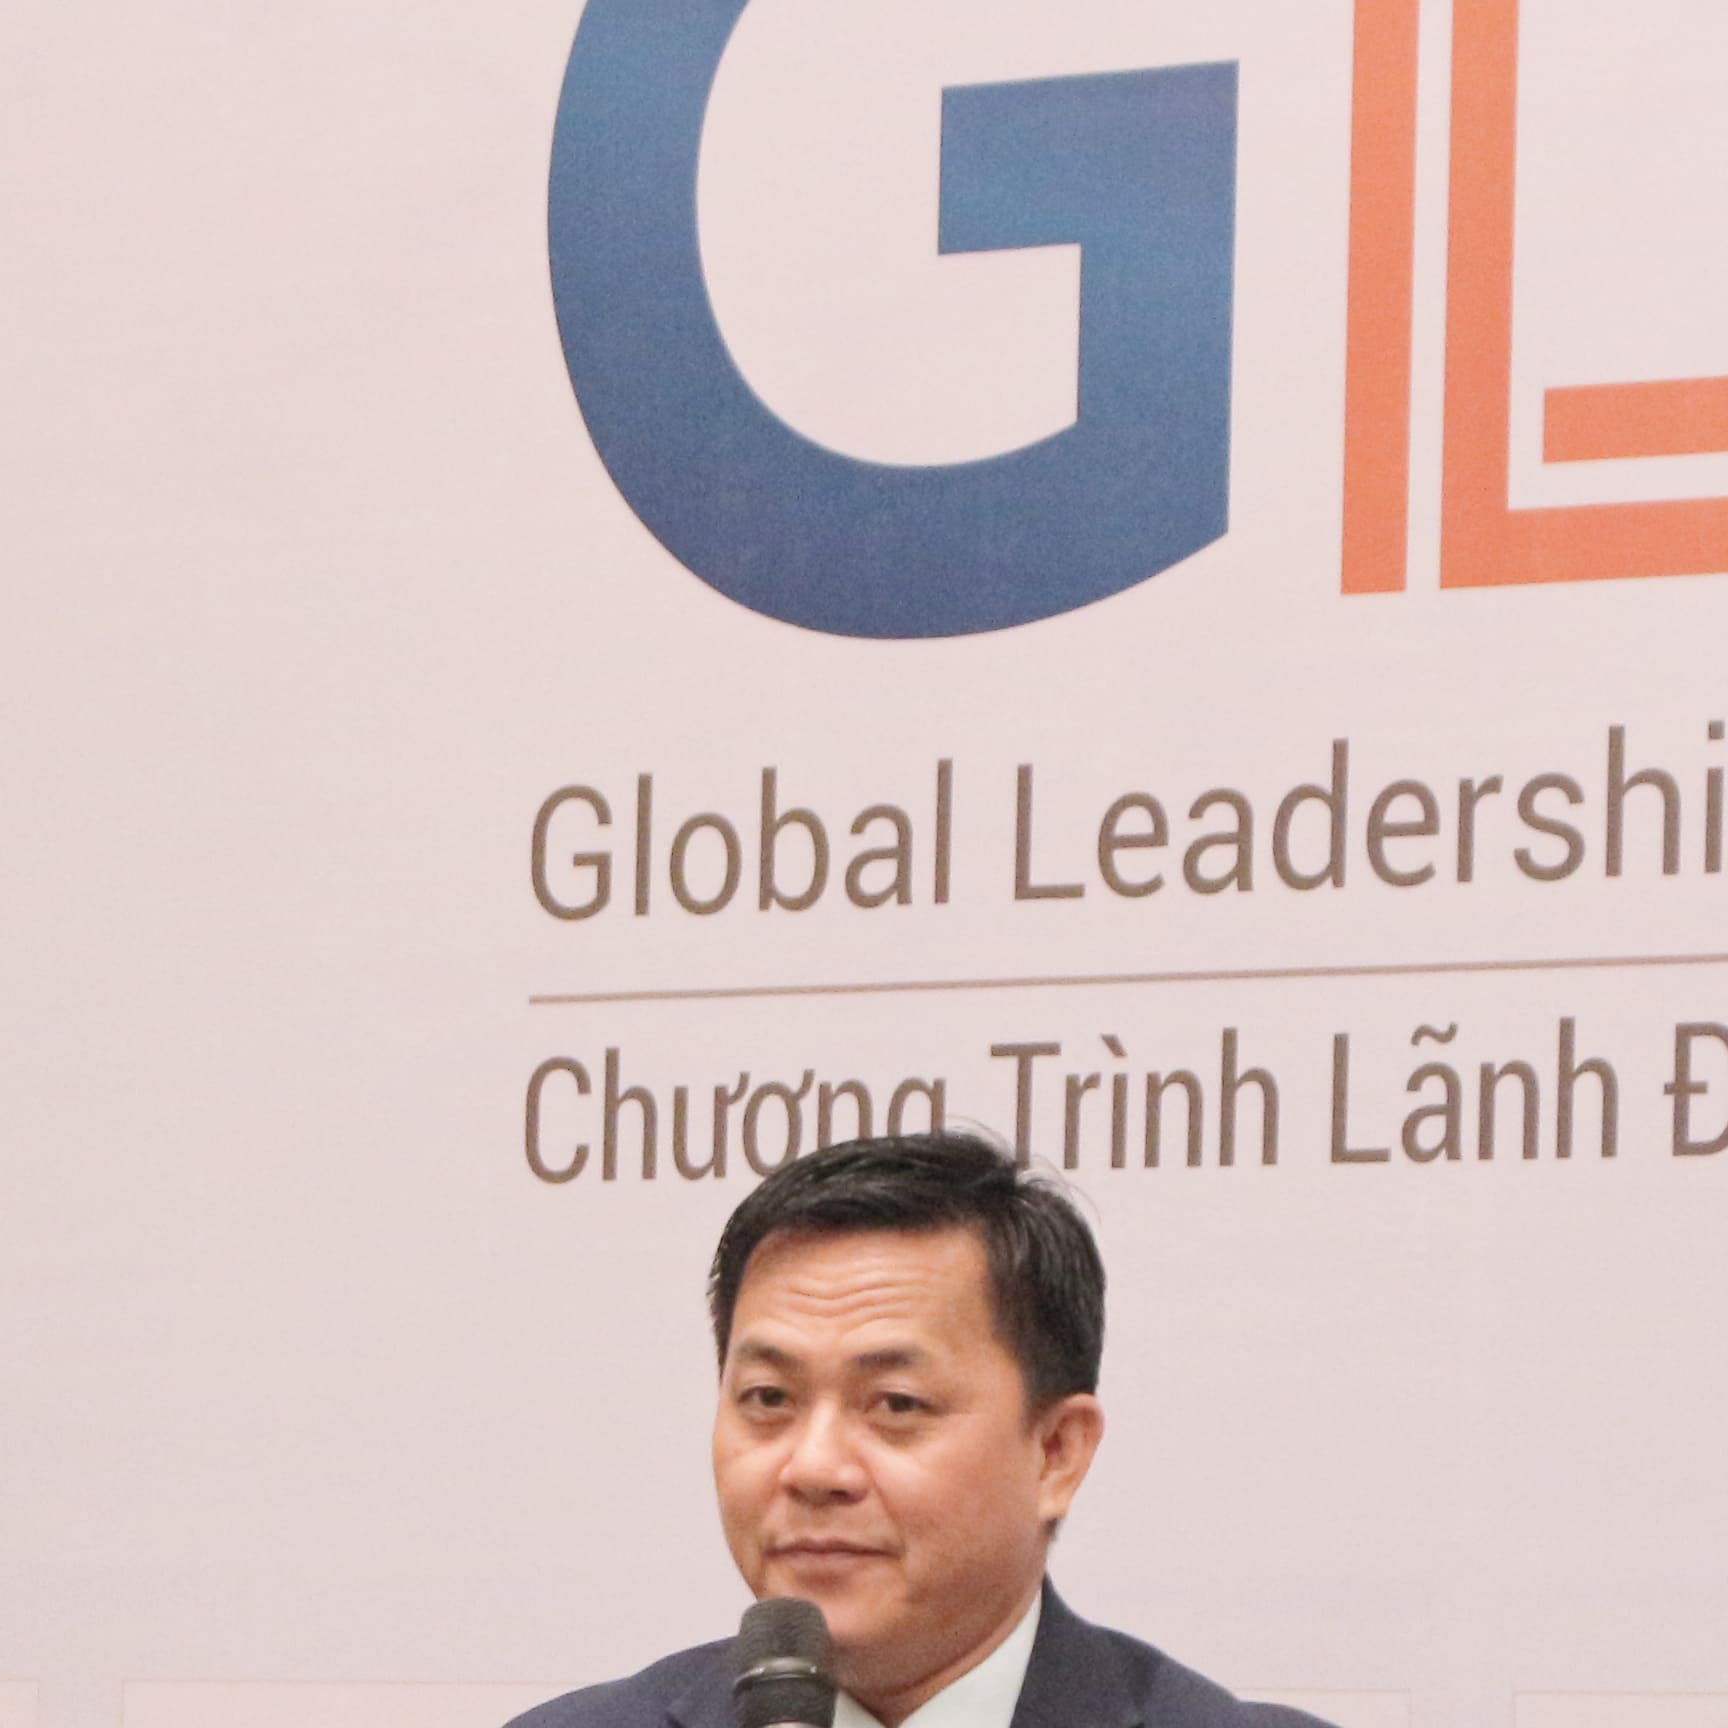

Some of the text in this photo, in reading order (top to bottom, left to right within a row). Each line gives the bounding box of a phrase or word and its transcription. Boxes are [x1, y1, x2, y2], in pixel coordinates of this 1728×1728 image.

[530, 758, 954, 923] Global
[989, 1027, 1280, 1171] Trình
[1329, 1016, 1619, 1166] Lãnh
